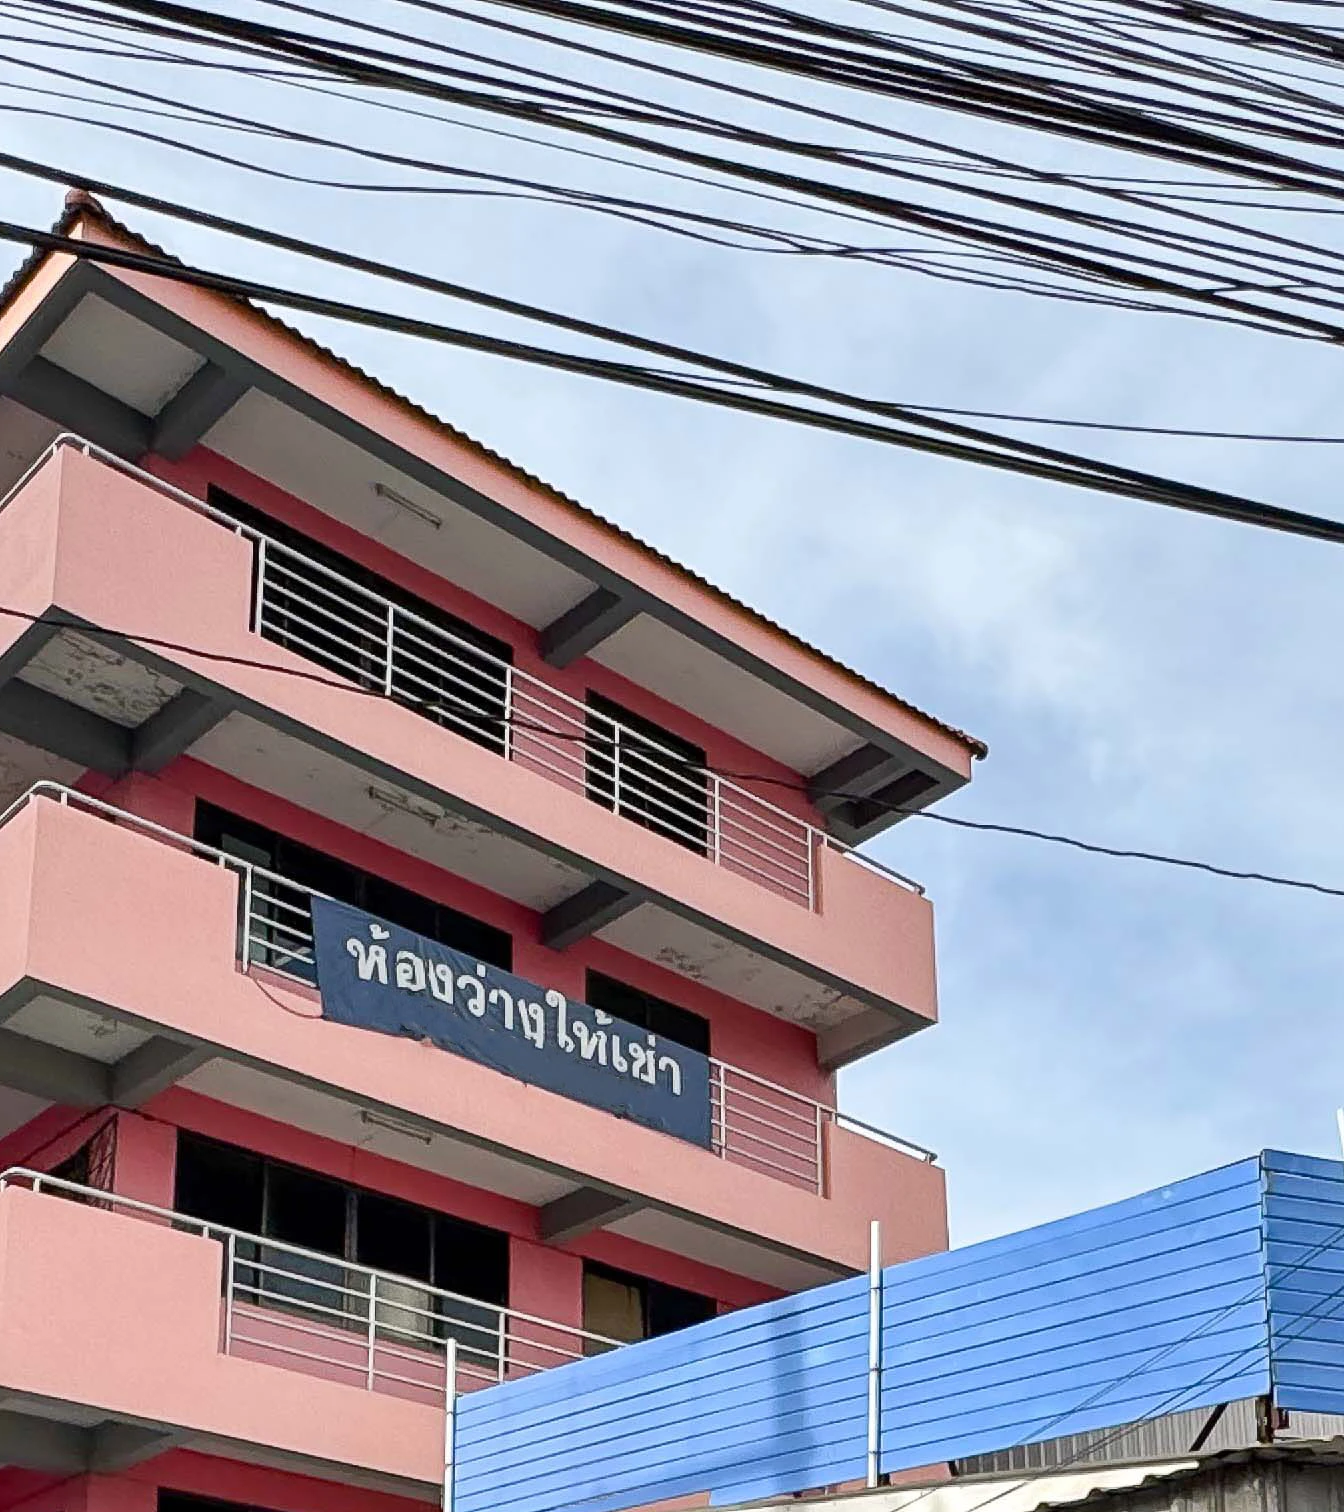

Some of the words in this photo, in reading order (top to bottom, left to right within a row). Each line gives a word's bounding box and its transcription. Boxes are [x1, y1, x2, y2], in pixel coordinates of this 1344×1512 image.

[346, 924, 682, 1096] ห้องว่างให้เช่า
